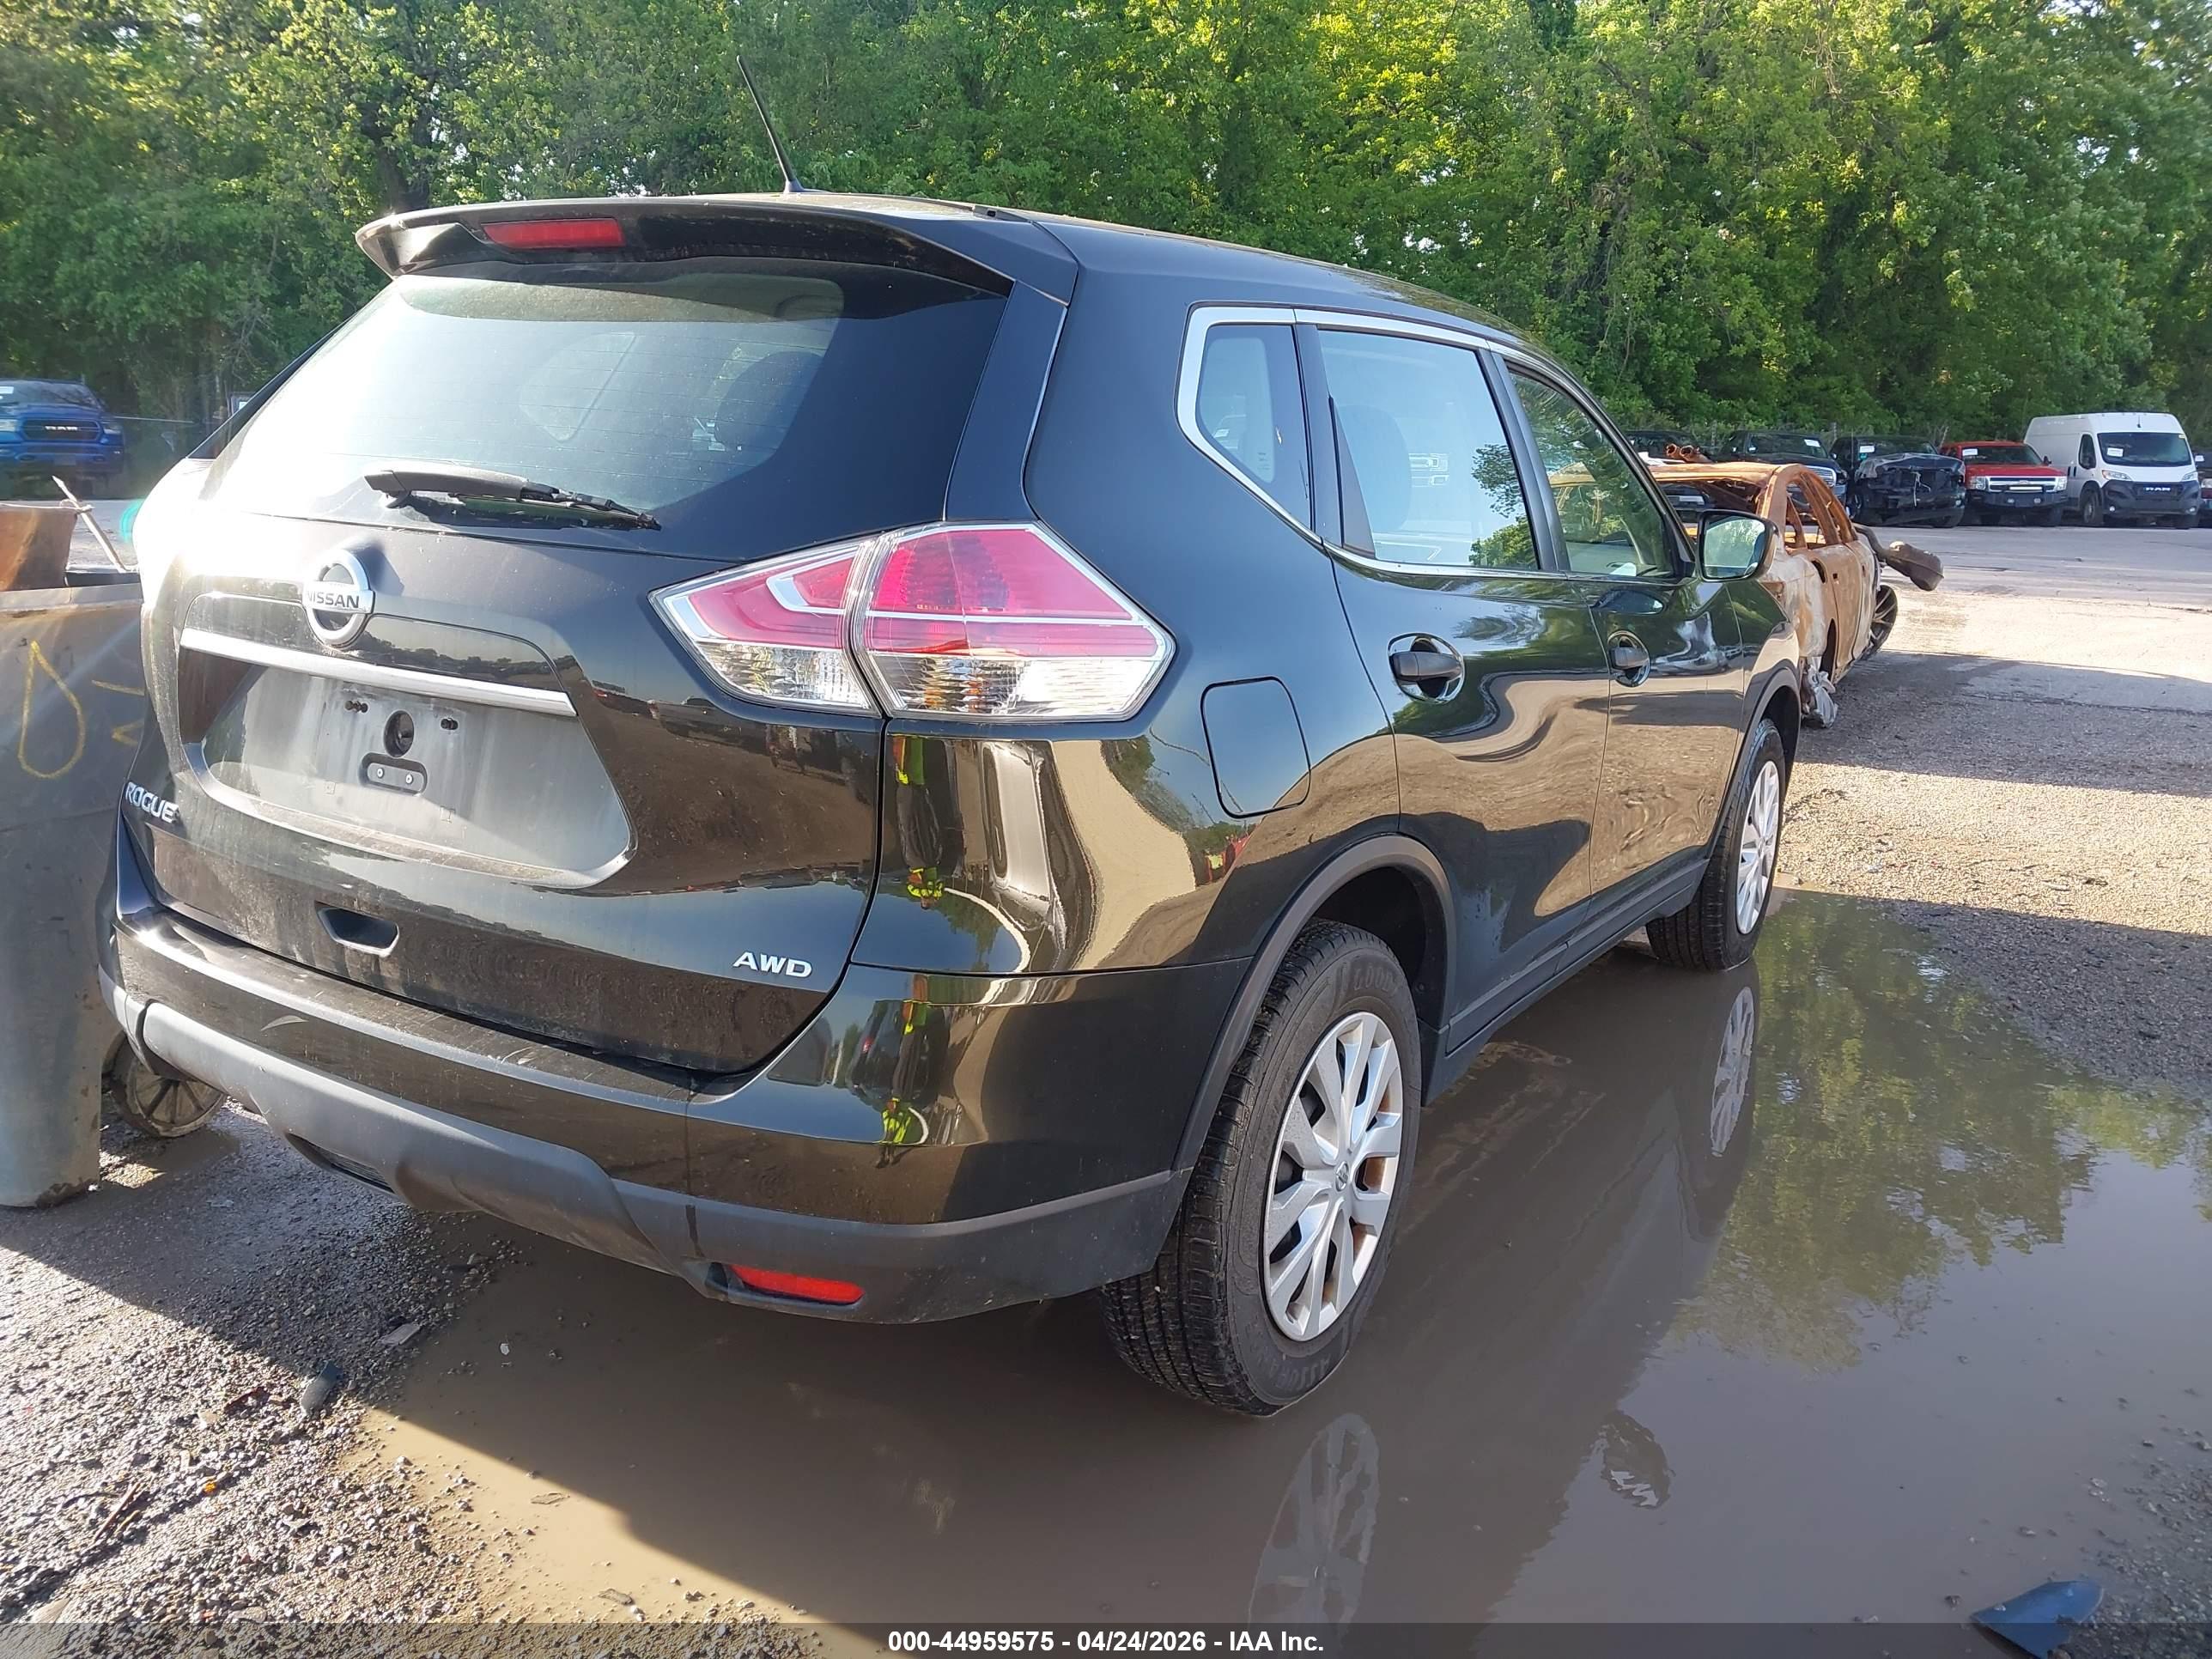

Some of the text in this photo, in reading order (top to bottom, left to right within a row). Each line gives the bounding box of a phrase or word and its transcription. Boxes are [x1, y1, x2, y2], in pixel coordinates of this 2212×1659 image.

[306, 590, 360, 609] NISSAN
[125, 781, 179, 823] ROGUE
[732, 951, 812, 978] AWD
